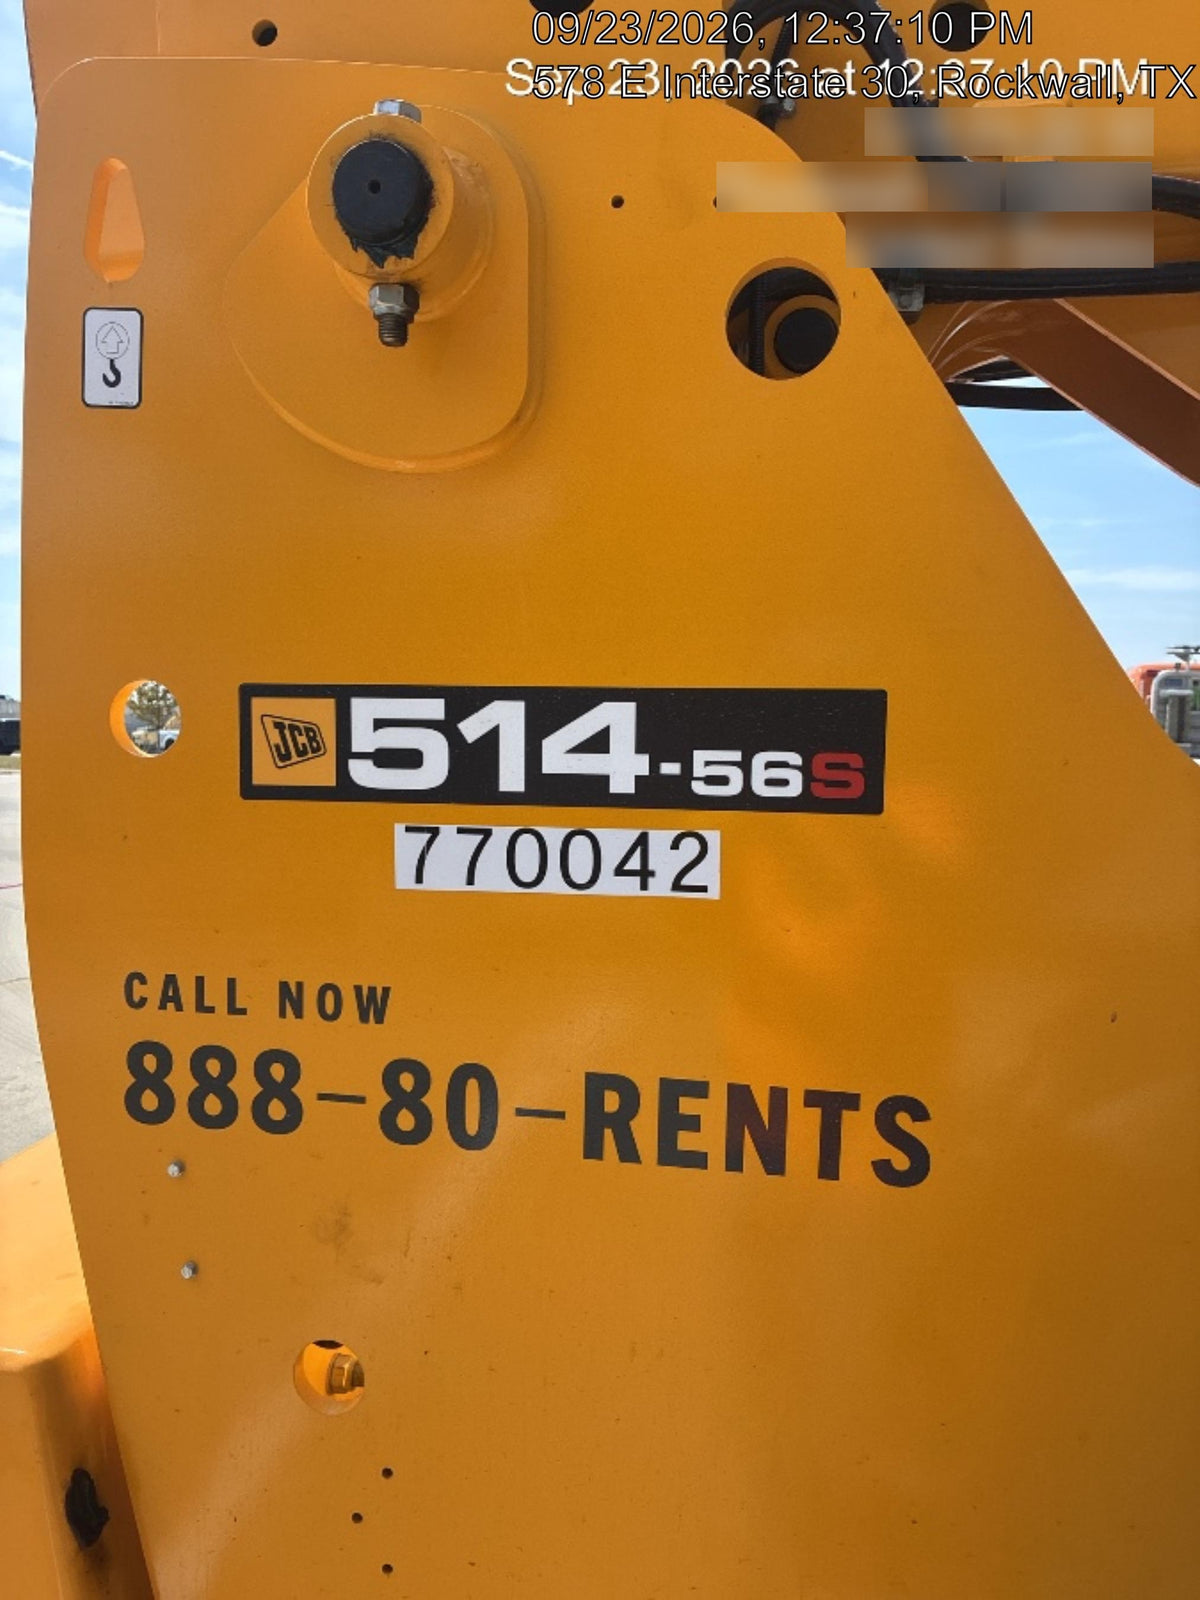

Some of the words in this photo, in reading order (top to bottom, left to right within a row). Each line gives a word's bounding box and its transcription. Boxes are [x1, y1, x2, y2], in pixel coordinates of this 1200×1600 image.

[272, 719, 322, 763] JCB
[404, 825, 710, 894] 770042
[124, 971, 248, 1017] CALL
[278, 980, 392, 1025] NOW
